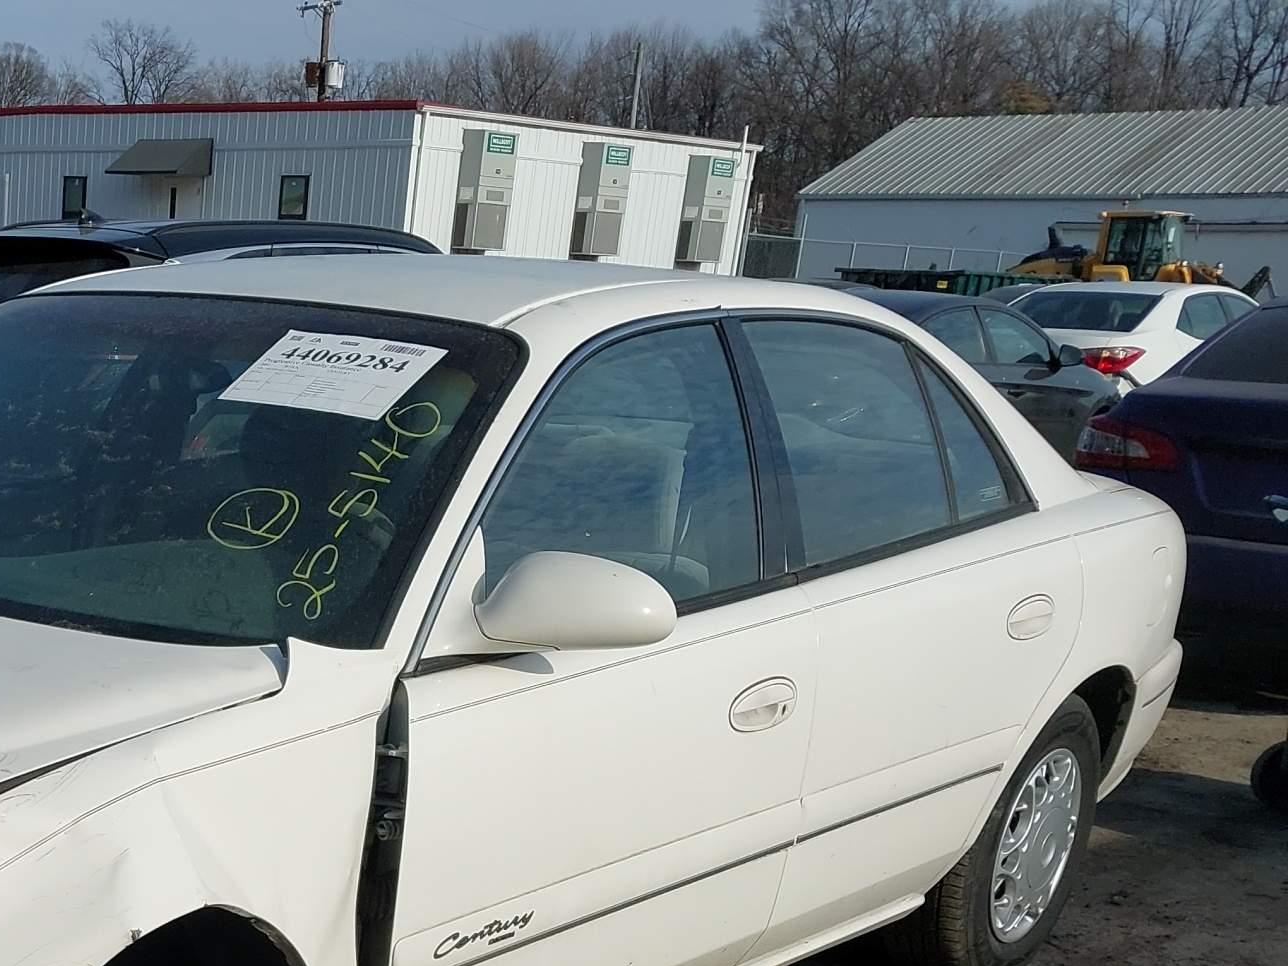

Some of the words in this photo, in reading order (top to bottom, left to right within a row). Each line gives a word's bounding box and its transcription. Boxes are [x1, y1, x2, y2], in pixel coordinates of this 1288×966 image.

[281, 347, 410, 373] 44069284
[276, 402, 441, 620] 25-5140
[433, 910, 535, 959] Century
